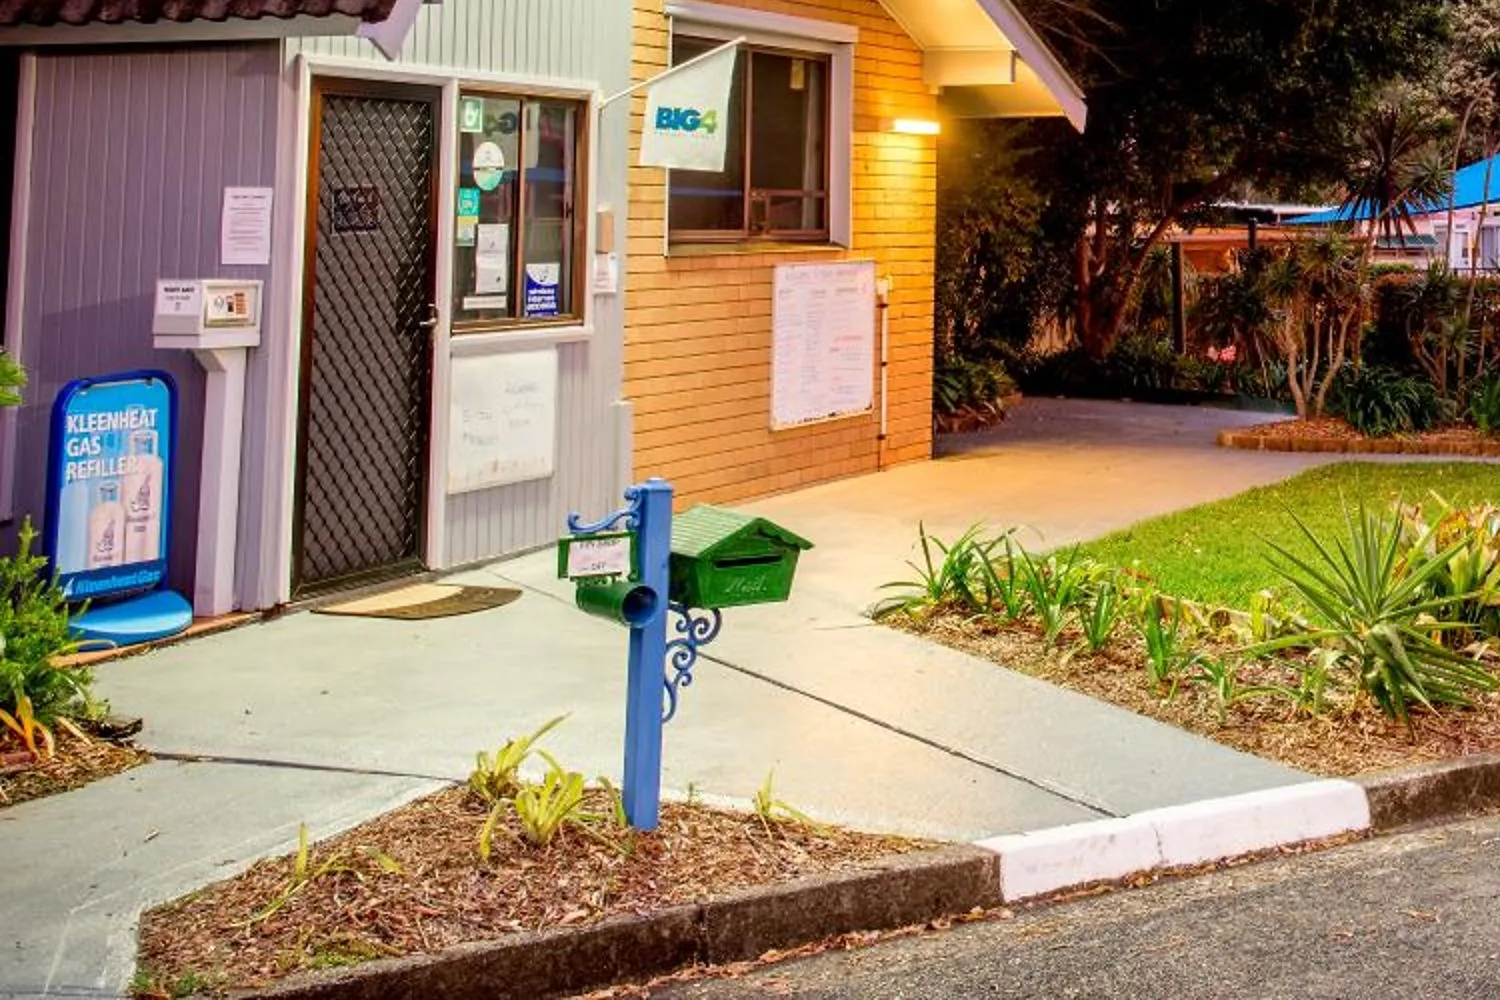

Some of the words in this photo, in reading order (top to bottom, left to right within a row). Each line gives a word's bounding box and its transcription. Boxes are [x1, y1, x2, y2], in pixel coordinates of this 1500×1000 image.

[655, 106, 718, 134] BIG4
[67, 408, 158, 433] KLEENHEAT
[67, 436, 101, 457] GAS
